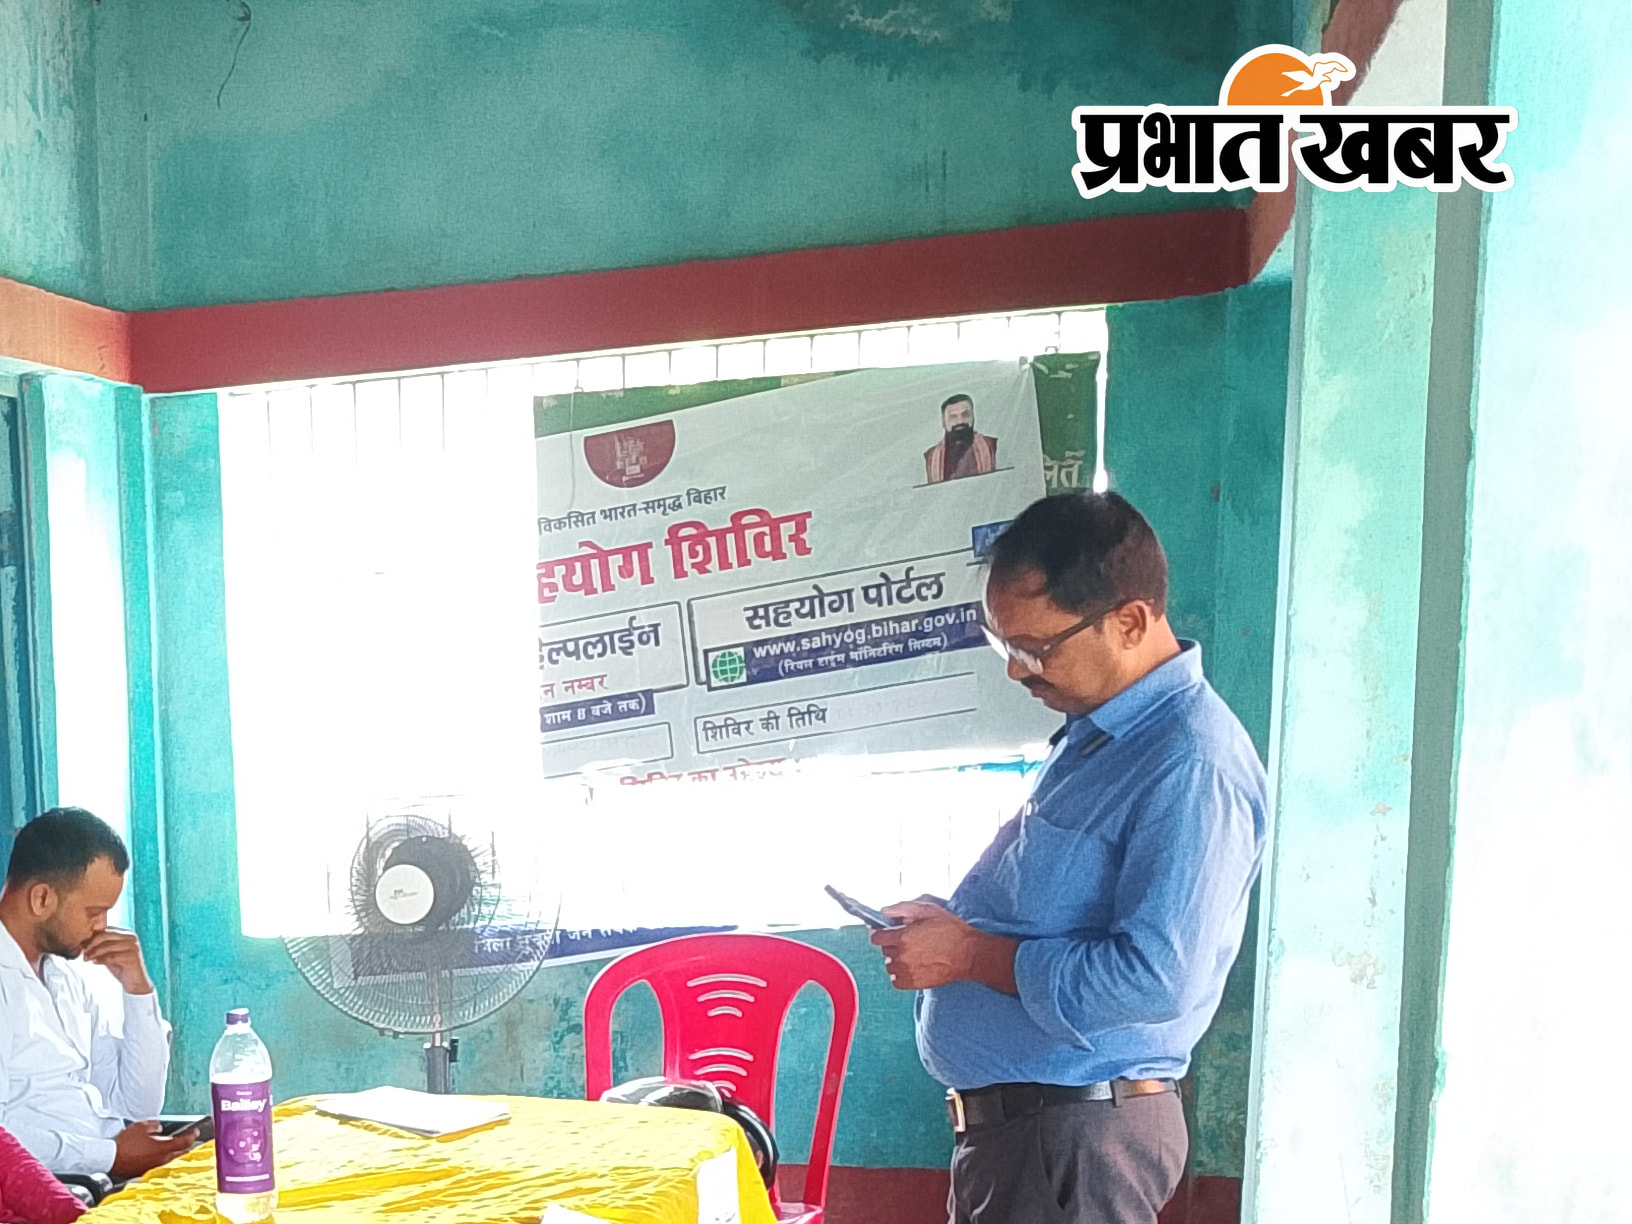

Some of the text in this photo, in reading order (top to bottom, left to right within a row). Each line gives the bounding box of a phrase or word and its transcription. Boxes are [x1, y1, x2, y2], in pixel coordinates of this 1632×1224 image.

[538, 510, 597, 537] विकसित
[664, 508, 813, 579] शिविर
[743, 566, 946, 630] सहयोग पोर्टल
[752, 607, 978, 659] www.sahyog.bihar.gov.in
[561, 673, 610, 695] नम्बर
[543, 692, 647, 725] शाम 8 बजे तक)
[701, 702, 829, 743] शिविर की तिथि
